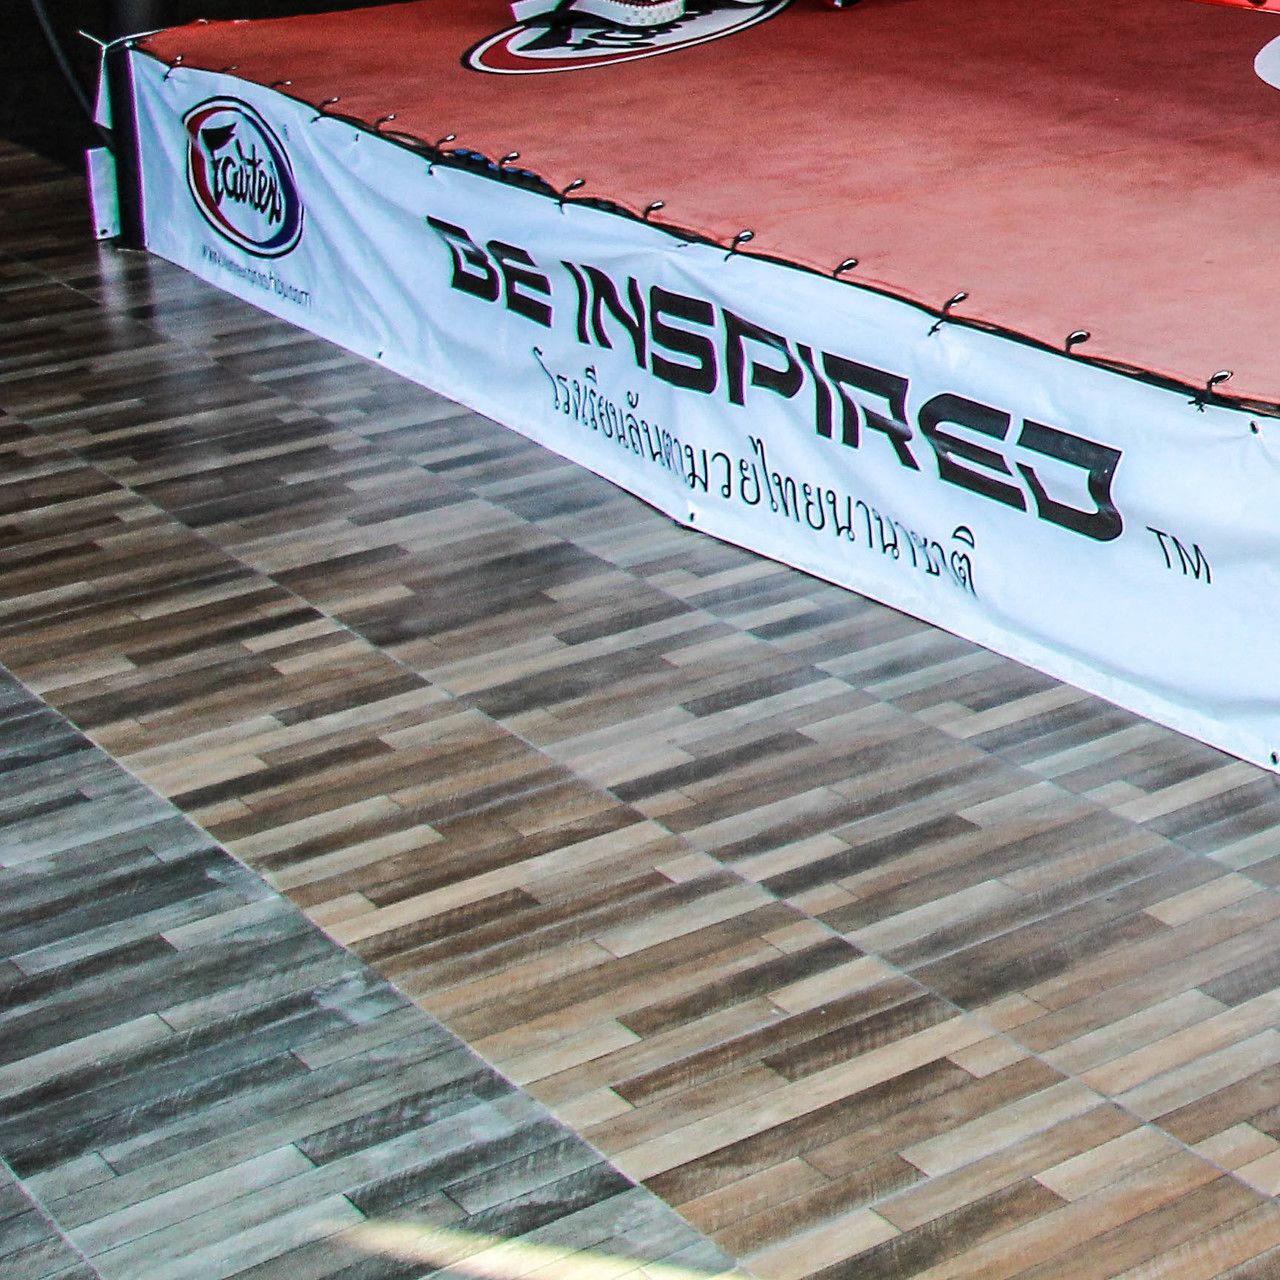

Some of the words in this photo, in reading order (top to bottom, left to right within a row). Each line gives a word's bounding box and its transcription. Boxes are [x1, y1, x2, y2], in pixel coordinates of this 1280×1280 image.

[200, 122, 283, 226] Fairtex
[426, 214, 554, 329] BE
[567, 259, 1123, 543] INSPIRED
